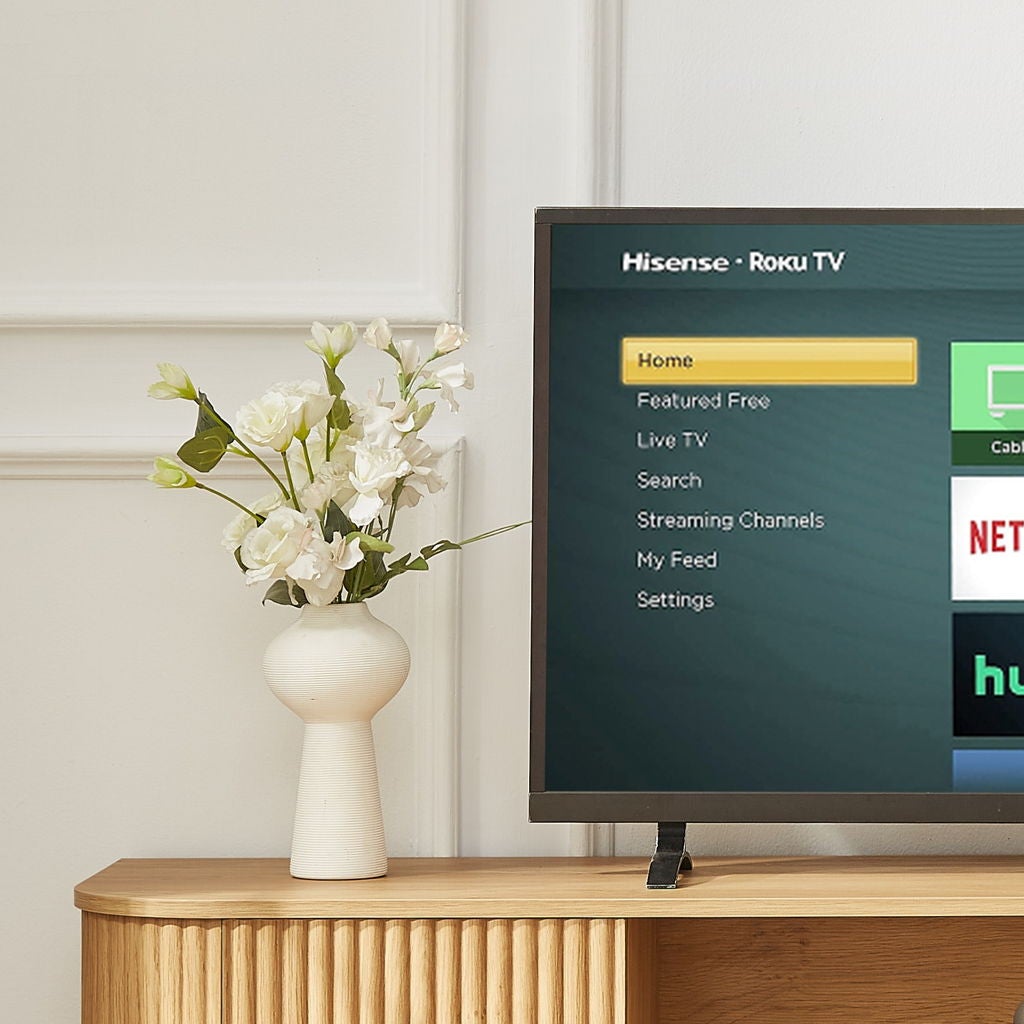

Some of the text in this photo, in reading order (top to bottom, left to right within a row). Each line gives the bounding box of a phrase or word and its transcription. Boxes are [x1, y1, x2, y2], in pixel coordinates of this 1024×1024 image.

[621, 252, 730, 272] Hisense
[812, 252, 846, 271] TV
[637, 352, 694, 369] Home
[636, 392, 771, 409] Featured Free
[636, 432, 708, 448] Live TV
[636, 472, 702, 488] Search
[636, 512, 825, 531] Streaming Channels
[636, 552, 717, 570] My Feed
[636, 592, 715, 611] Settings
